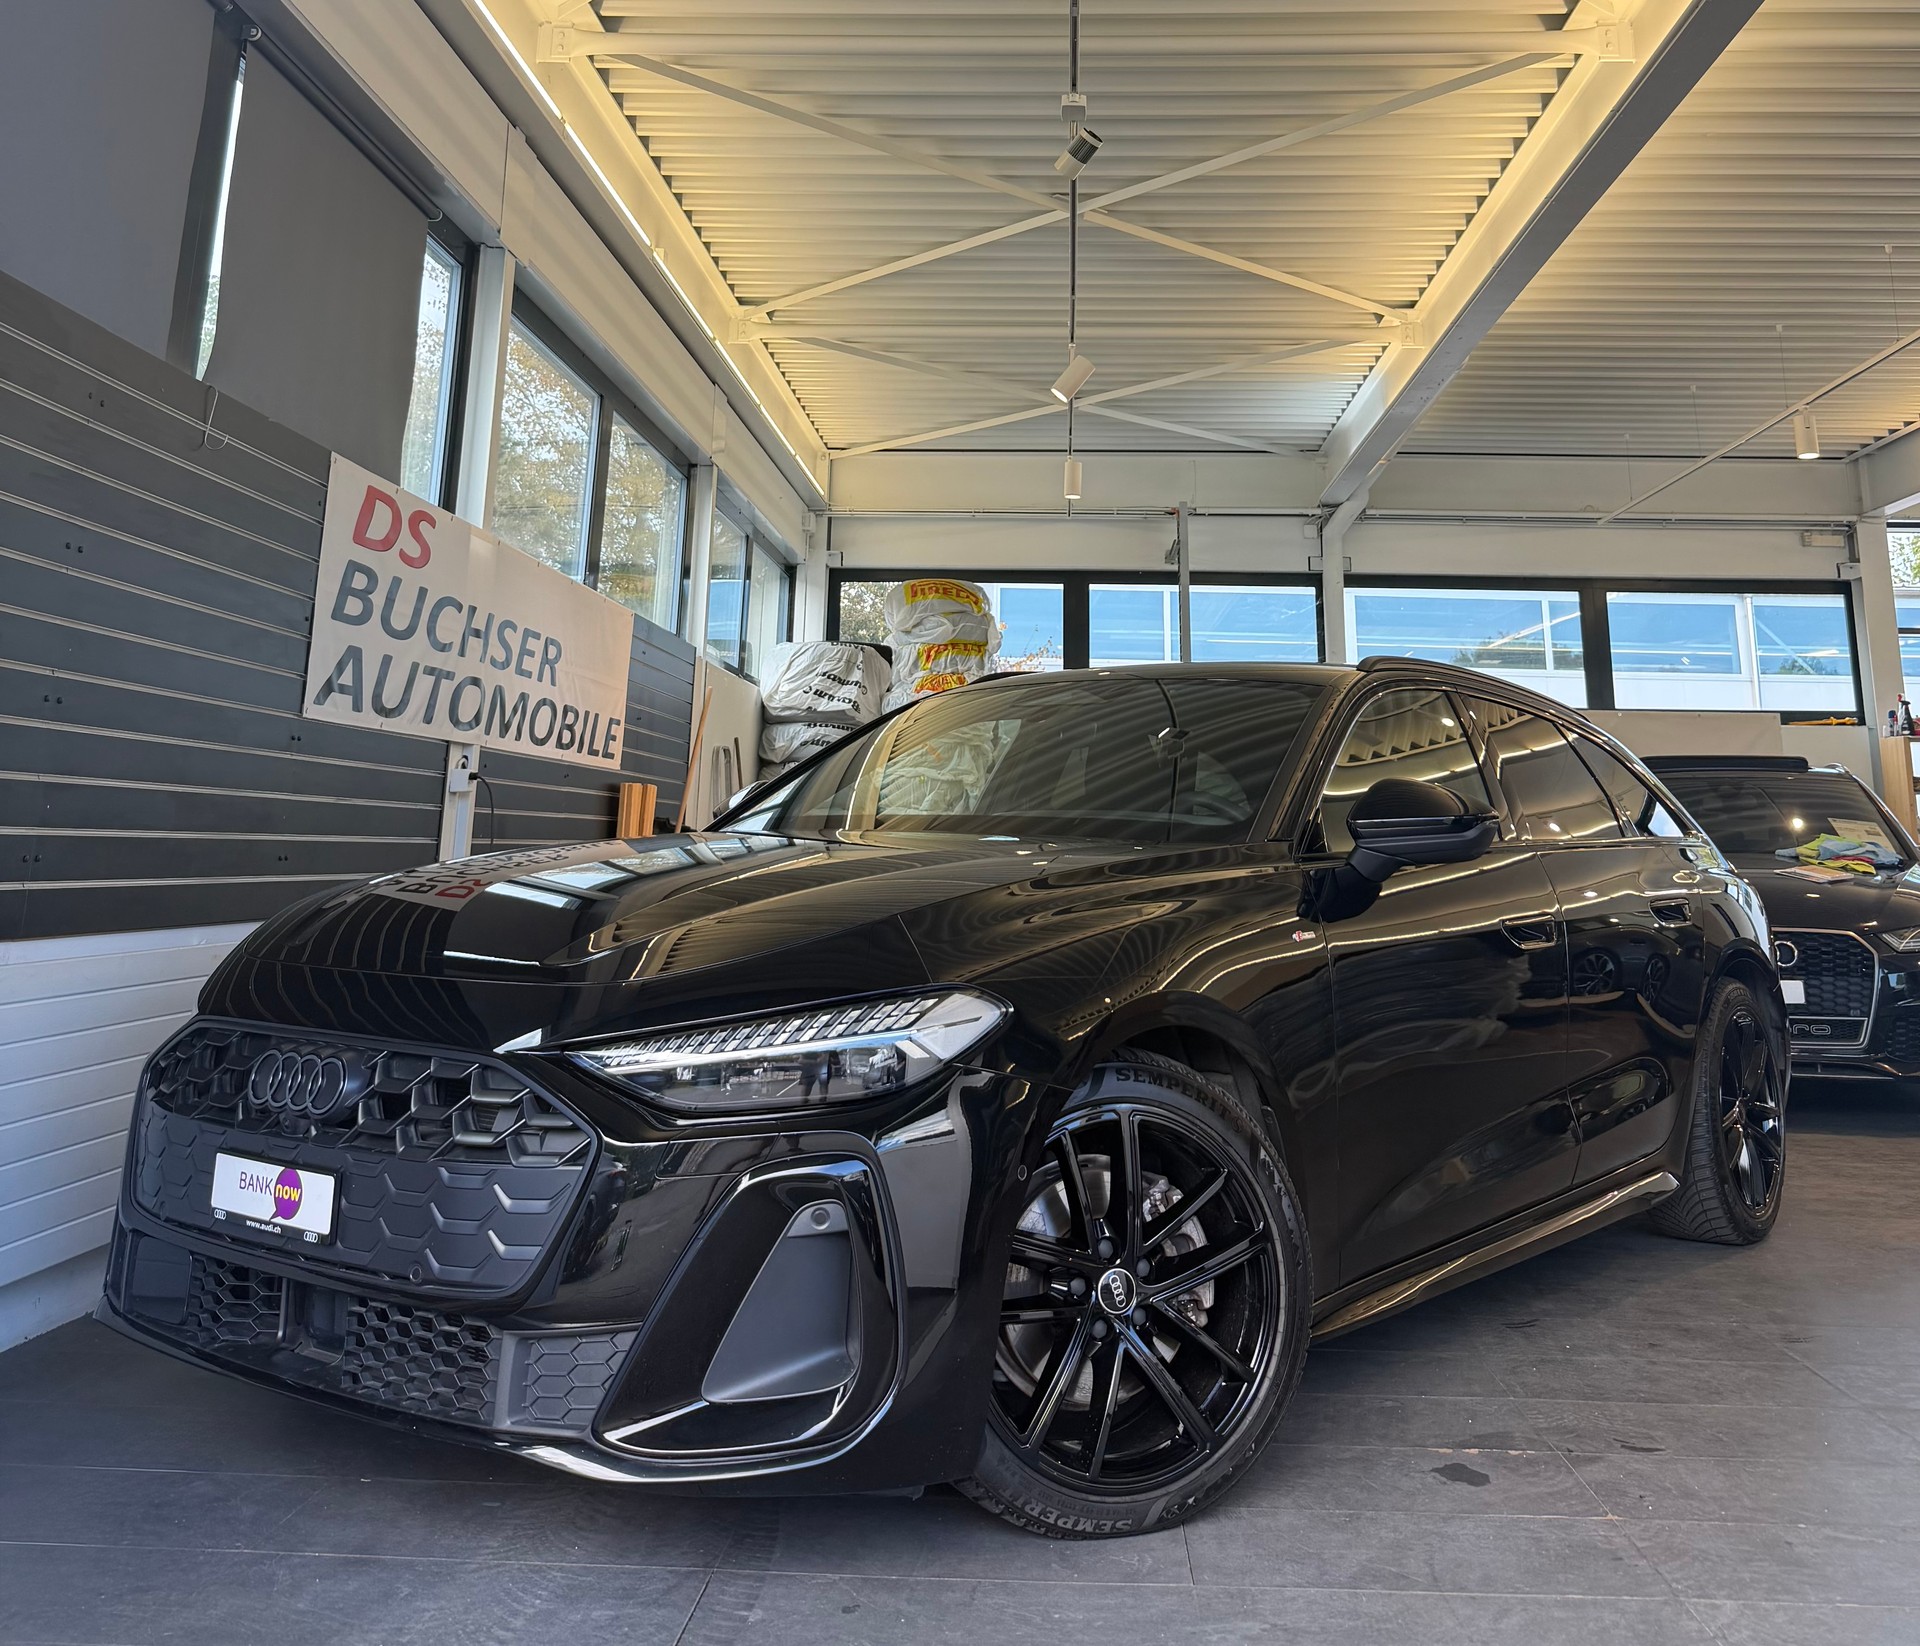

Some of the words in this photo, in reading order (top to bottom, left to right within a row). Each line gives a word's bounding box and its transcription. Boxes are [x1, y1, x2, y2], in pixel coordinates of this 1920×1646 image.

[352, 484, 436, 569] DS
[331, 559, 562, 687] BUCHSER
[313, 645, 621, 760] AUTOMOBILE
[1115, 1067, 1231, 1120] SEMPERIT
[239, 1171, 274, 1196] BANK
[275, 1184, 301, 1202] now
[246, 1219, 281, 1234] www.audi.ch
